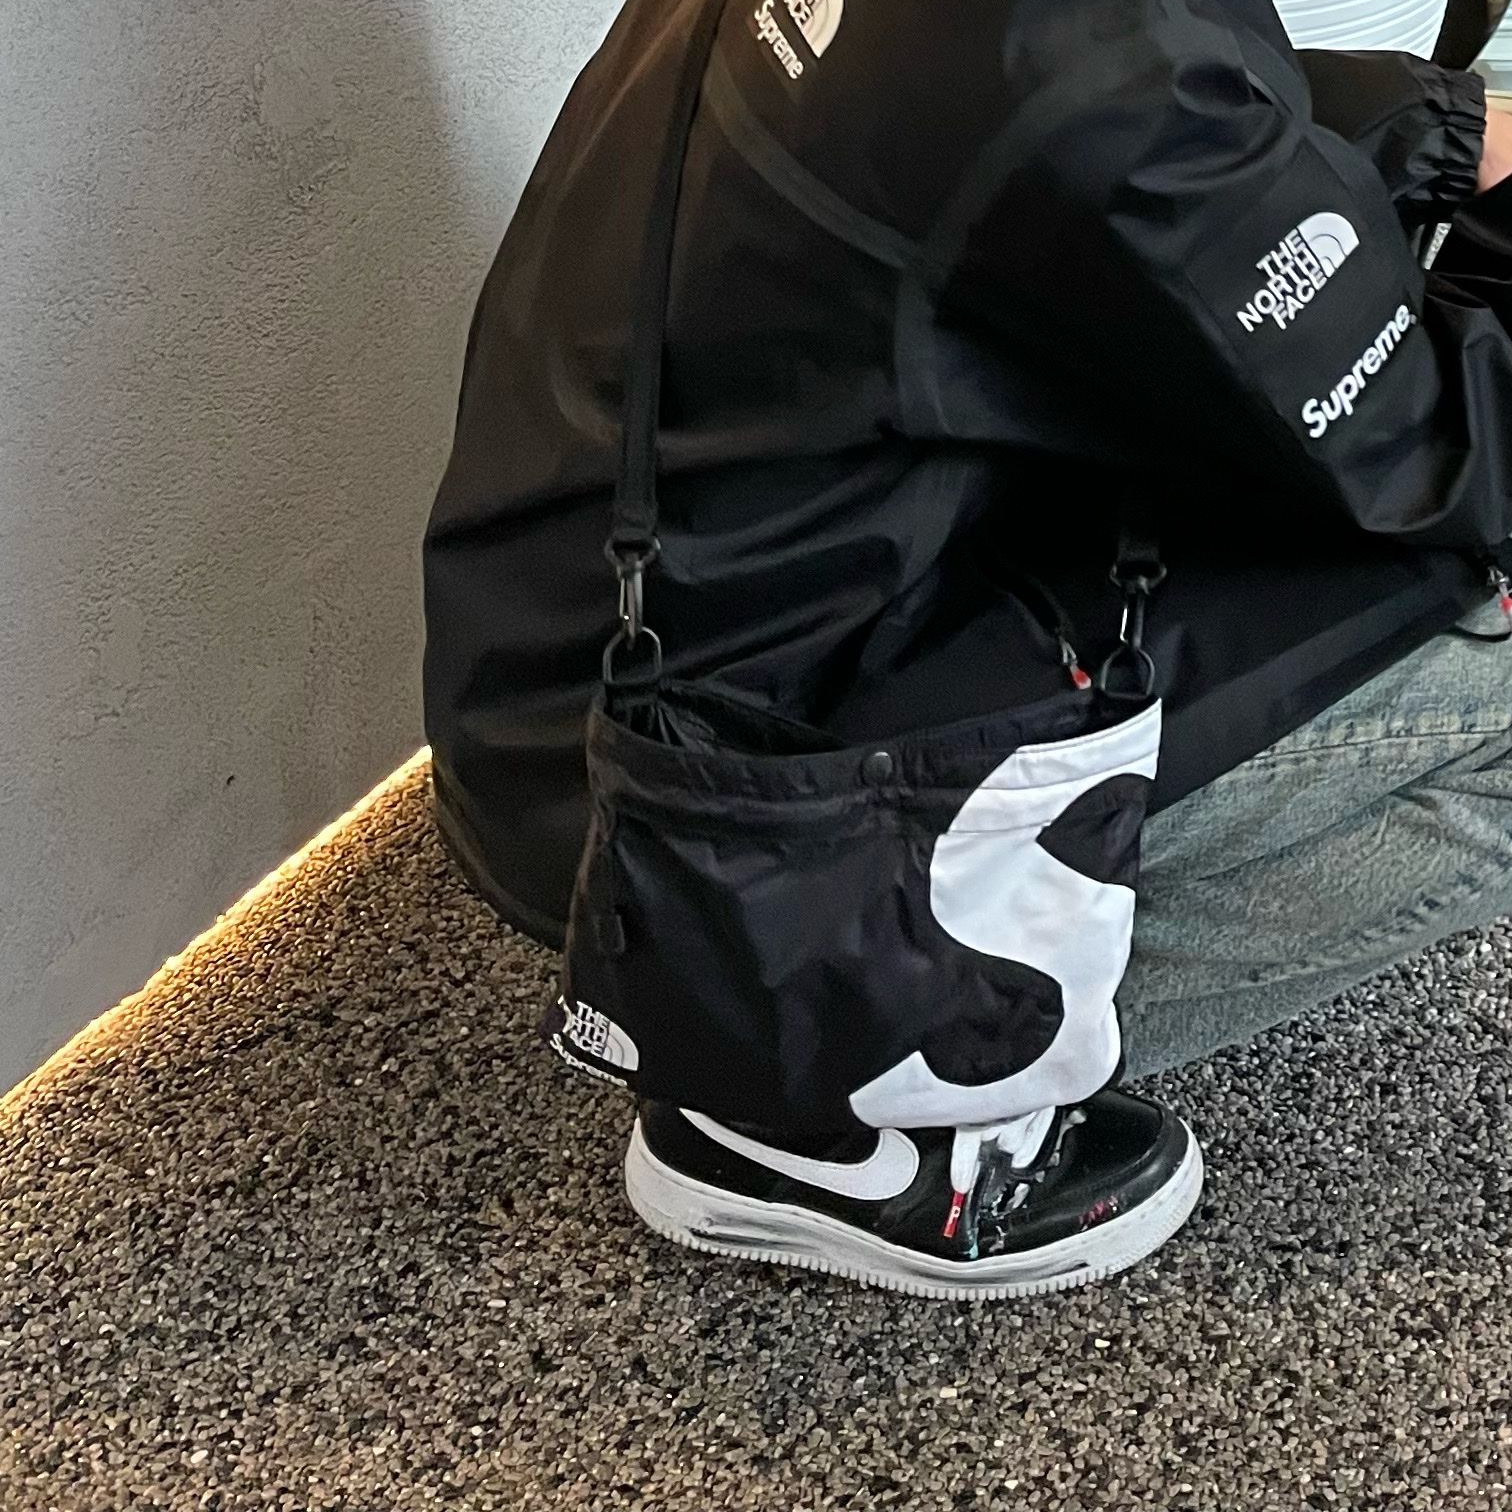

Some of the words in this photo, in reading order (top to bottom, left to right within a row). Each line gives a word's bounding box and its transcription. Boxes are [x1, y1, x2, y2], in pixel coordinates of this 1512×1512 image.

[1256, 228, 1304, 277] THE
[1236, 247, 1320, 332] NORTH
[1272, 274, 1328, 330] FACE
[1302, 304, 1410, 438] Supreme
